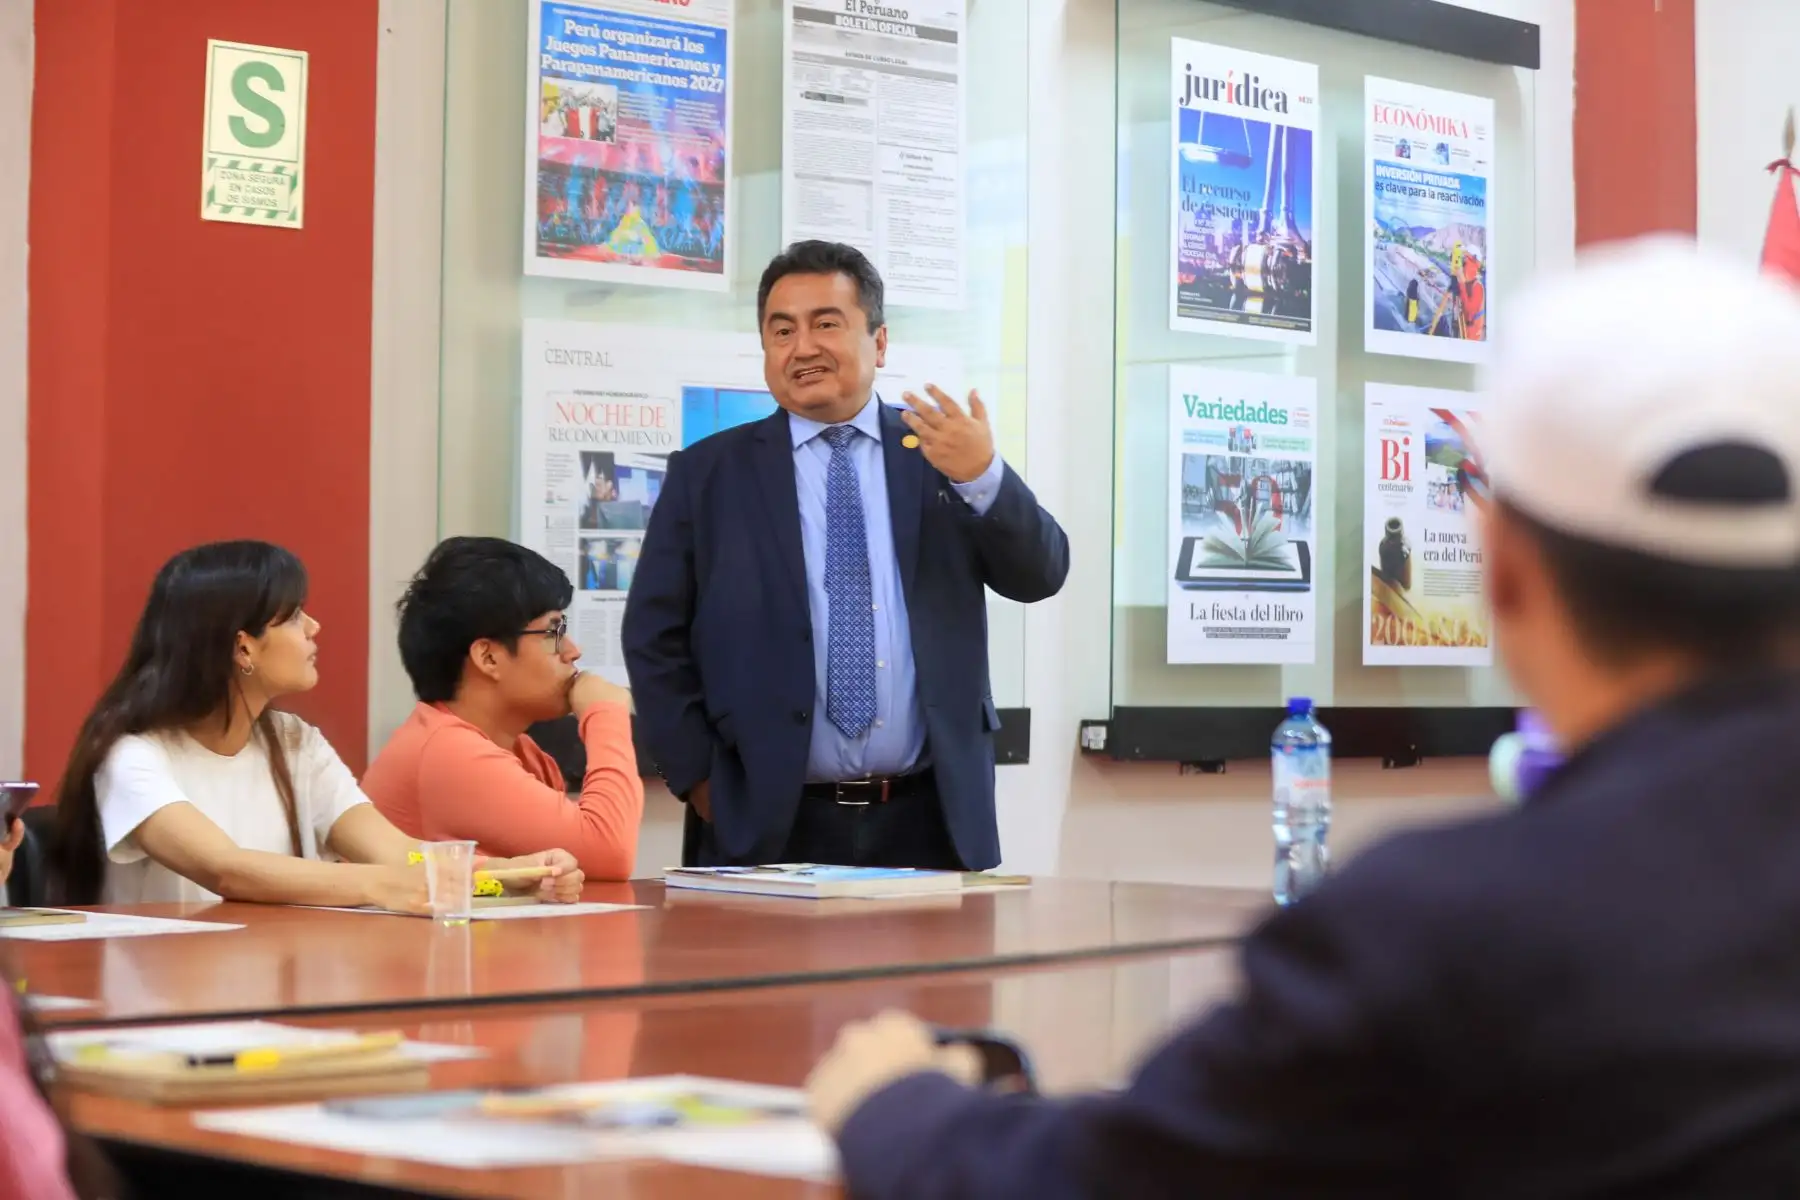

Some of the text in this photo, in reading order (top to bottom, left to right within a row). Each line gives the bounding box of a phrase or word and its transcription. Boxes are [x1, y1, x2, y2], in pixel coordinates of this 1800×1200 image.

[845, 0, 908, 21] El Peruano
[564, 19, 600, 37] Perú
[602, 27, 681, 51] organizará
[683, 37, 704, 54] los
[835, 14, 918, 37] BOLETÍN OFICIAL
[546, 36, 721, 78] Juegos Panamericanos y
[541, 54, 724, 93] Parapanamericanos 2027
[1179, 62, 1288, 114] jurídica
[228, 60, 286, 149] S
[1373, 104, 1468, 139] ECONÓMIKA
[220, 171, 285, 186] ZONA SEGURA
[1376, 164, 1422, 184] INVERSIÓN
[229, 182, 276, 196] EN CASOS
[1182, 173, 1251, 201] El recurso
[1375, 181, 1384, 190] es
[1386, 183, 1407, 196] clave
[1408, 186, 1427, 199] para
[1428, 188, 1436, 200] la
[1437, 190, 1484, 208] reactivación
[227, 195, 278, 208] DE SISMOS
[1182, 195, 1198, 212] de
[545, 348, 613, 368] CENTRAL
[556, 401, 666, 428] NOCHE DE
[1183, 394, 1289, 425] Variedades
[548, 427, 672, 446] RECONOCIMIENTO
[1380, 436, 1411, 482] Bi
[1378, 482, 1414, 493] centenario
[1424, 529, 1467, 544] La nueva
[1423, 547, 1483, 563] era del Perú
[1190, 602, 1304, 622] La fiesta del libro
